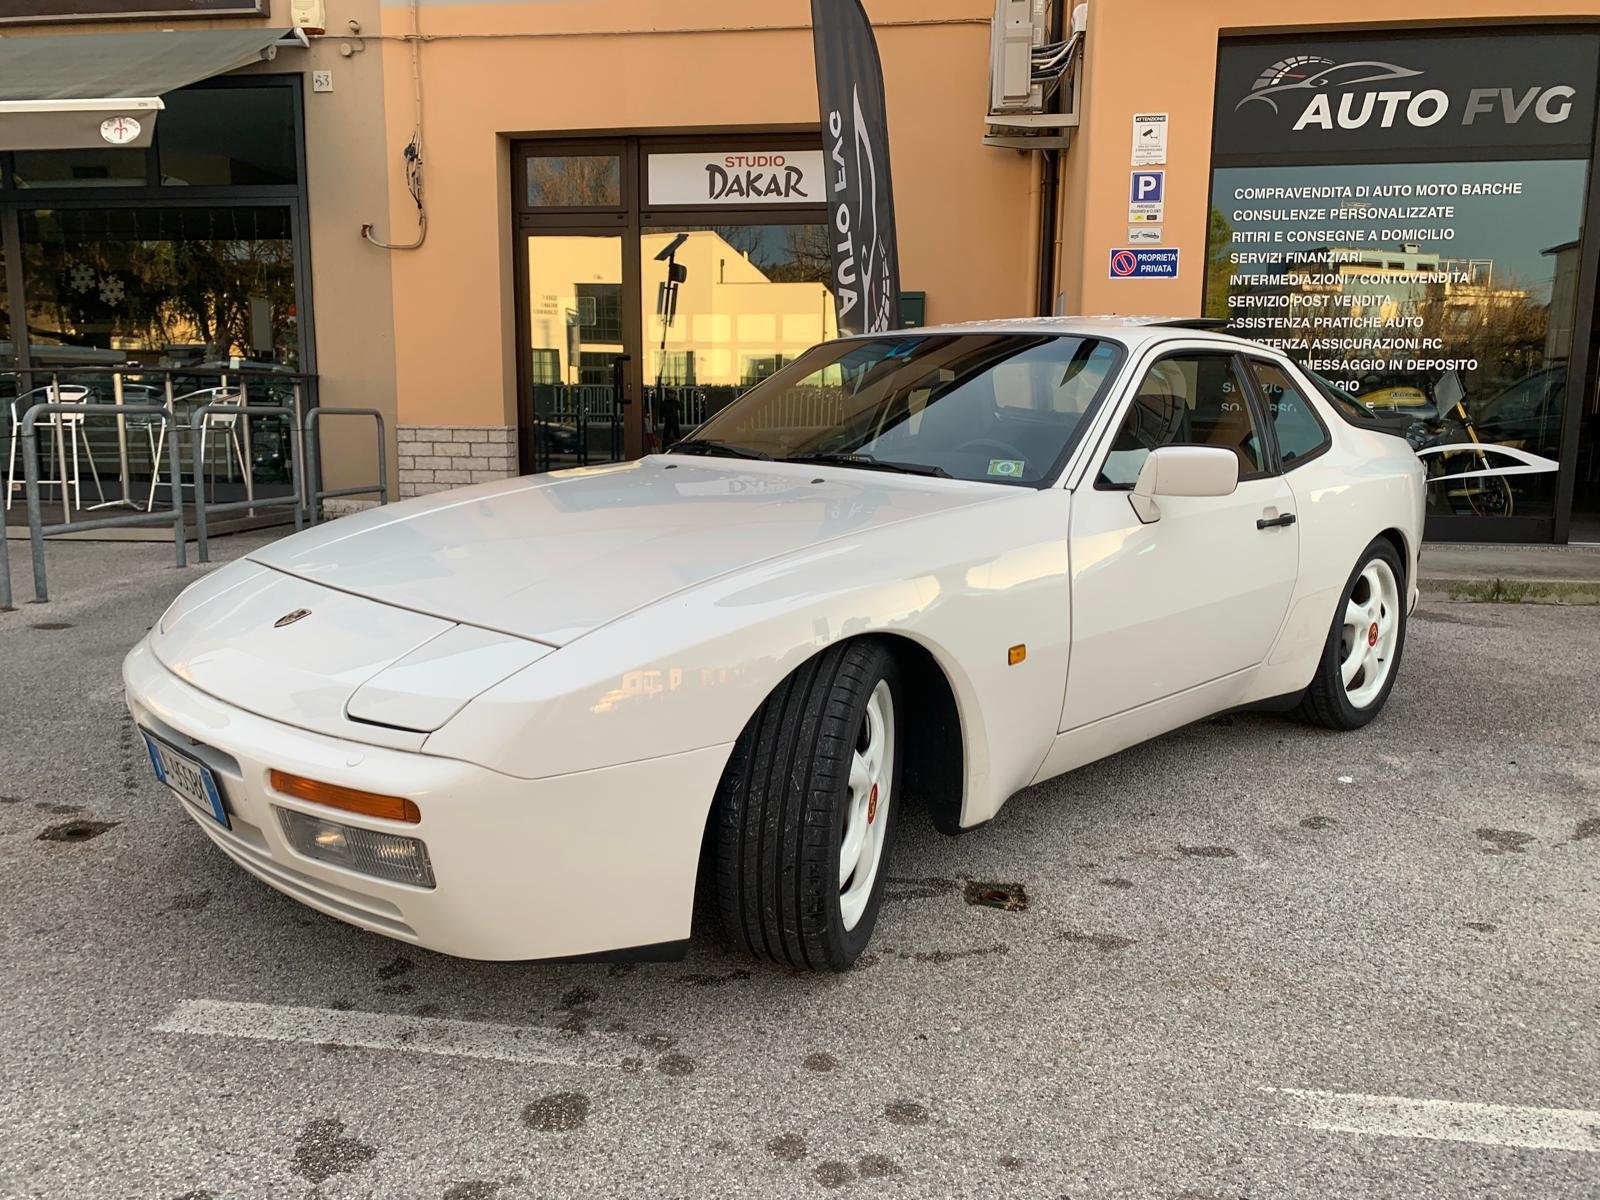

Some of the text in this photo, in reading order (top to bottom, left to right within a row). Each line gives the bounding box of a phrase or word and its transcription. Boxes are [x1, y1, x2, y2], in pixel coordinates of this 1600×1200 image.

[1292, 85, 1577, 130] AUTO FVG
[725, 155, 786, 168] STUDIO
[705, 163, 809, 200] DAKAR
[1138, 175, 1157, 200] P
[1234, 182, 1523, 200] COMPRAVENDITA DI AUTO MOTO BARCHE
[1233, 206, 1455, 222] CONSULENZE PERSONALIZZATE
[1231, 228, 1455, 243] RITIRI E CONSEGNE A DOMICILIO
[1229, 251, 1363, 264] SERVIZI FINANZIARI
[1140, 264, 1172, 273] PRIVATA
[1229, 272, 1470, 286] INTERMEDIAZIONI / CONTOVENDITA
[1228, 294, 1392, 308] SERVIZIO POST VENDITA
[1226, 316, 1424, 329] ASSISTENZA PRATICHE AUTO
[1312, 338, 1419, 350] ASSICURAZIONI
[1422, 338, 1443, 349] RC
[1299, 359, 1478, 371] MESSAGGIO IN DEPOSITO
